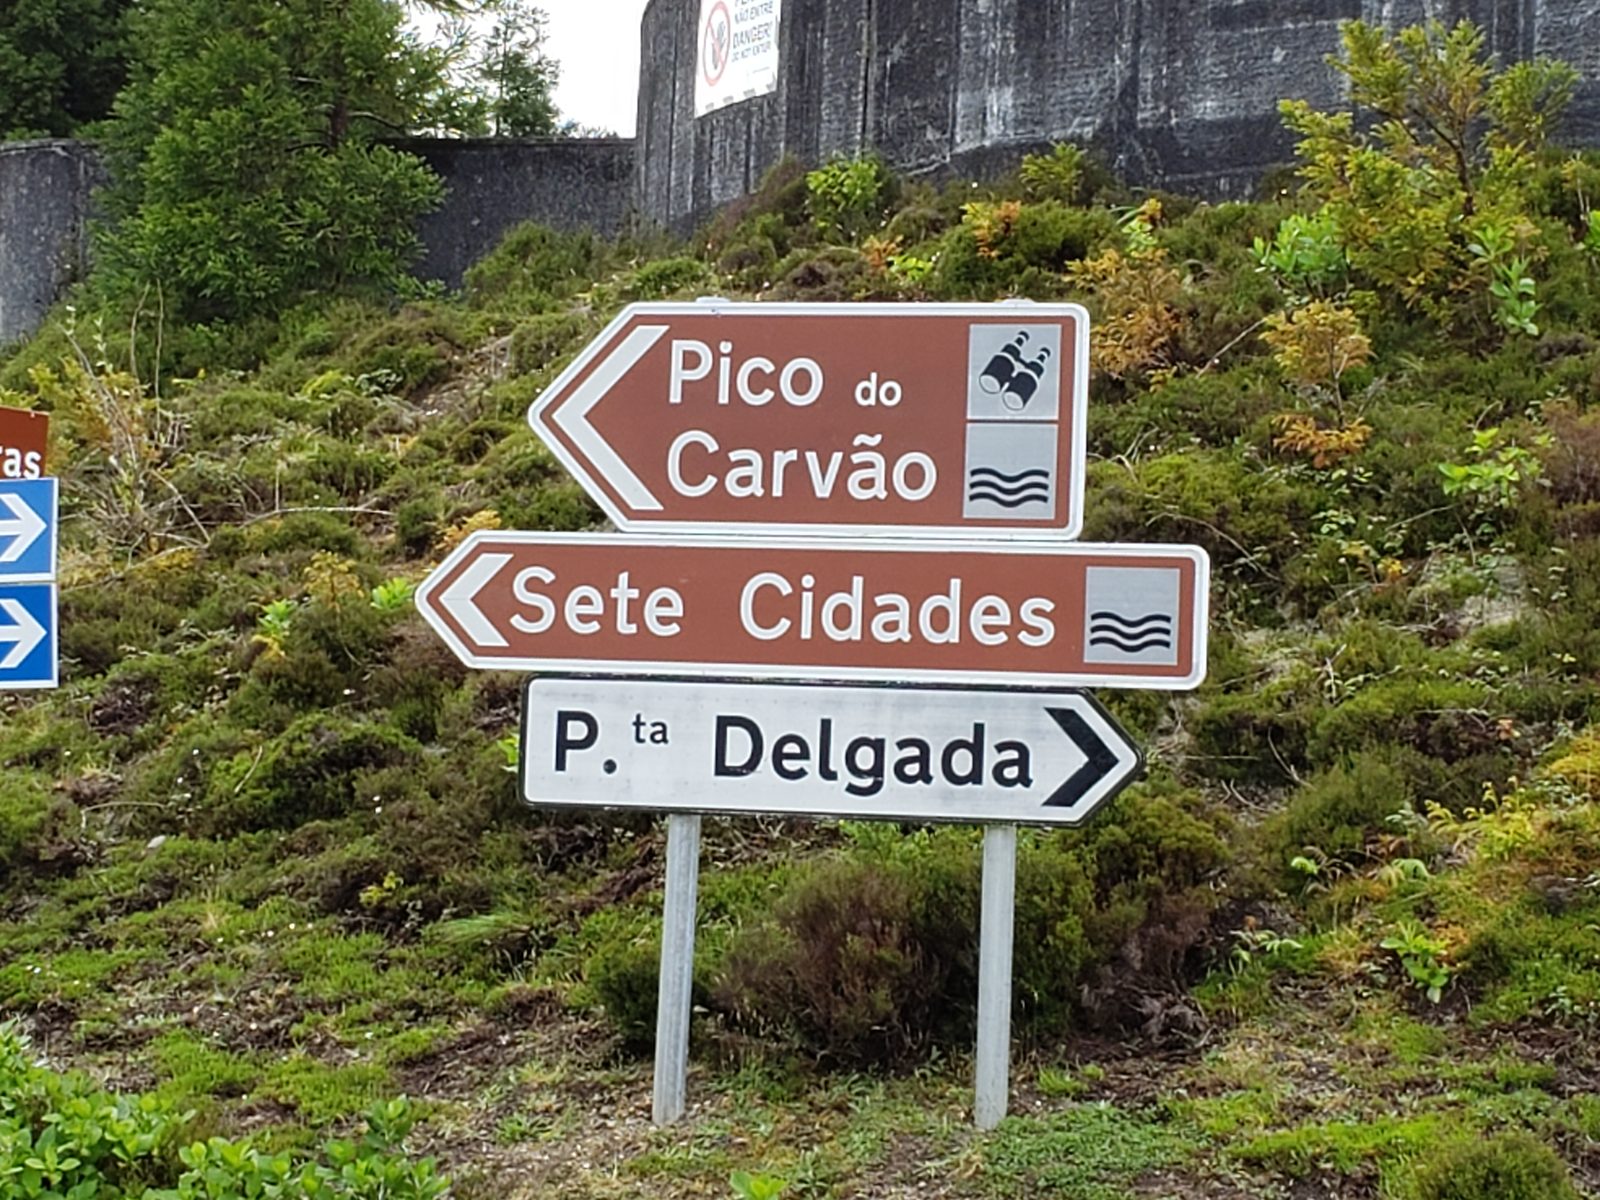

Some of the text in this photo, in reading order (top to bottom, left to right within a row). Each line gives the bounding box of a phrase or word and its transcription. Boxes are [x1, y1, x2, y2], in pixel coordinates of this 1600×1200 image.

[669, 339, 902, 407] Pico do
[0, 446, 41, 479] as
[667, 429, 937, 501] Carvão
[509, 566, 1055, 647] Sete Cidades
[714, 715, 1034, 797] Delgada
